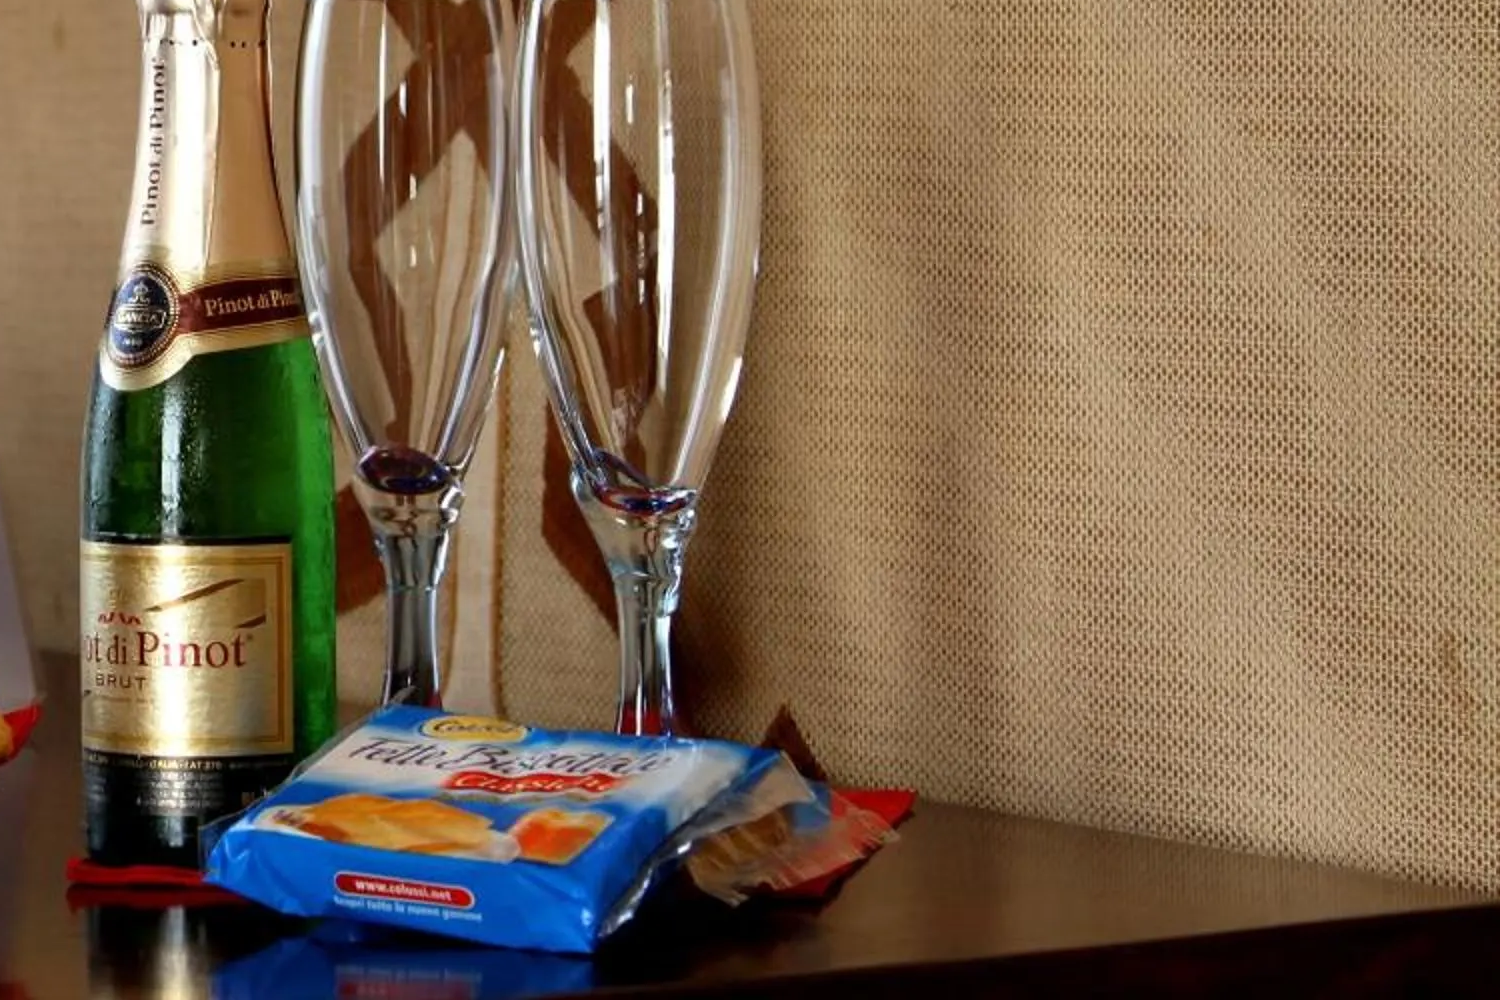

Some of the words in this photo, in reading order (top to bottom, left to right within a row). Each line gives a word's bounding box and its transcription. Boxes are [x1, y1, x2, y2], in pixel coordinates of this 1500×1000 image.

[204, 296, 255, 317] Pinot
[257, 293, 269, 308] di
[269, 289, 297, 308] Pin
[106, 634, 128, 665] di
[137, 631, 247, 669] Pinot
[96, 673, 147, 691] BRUT
